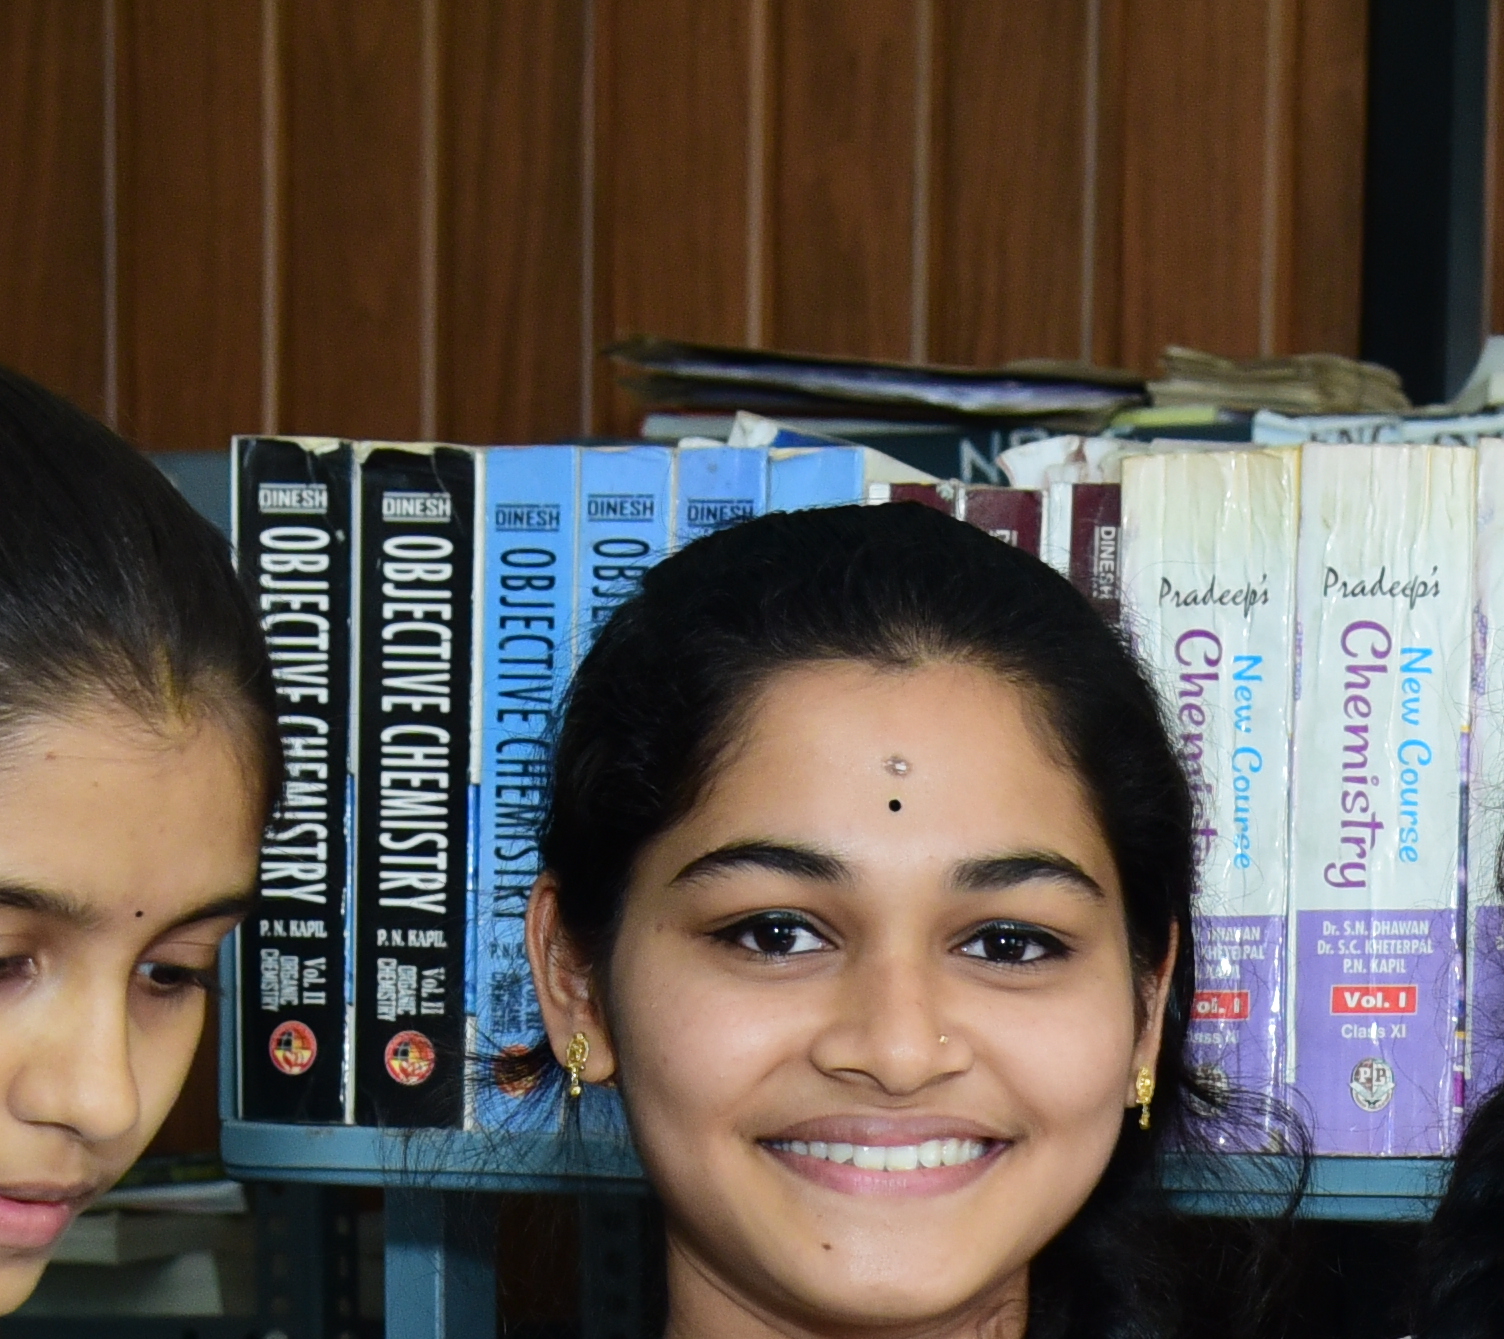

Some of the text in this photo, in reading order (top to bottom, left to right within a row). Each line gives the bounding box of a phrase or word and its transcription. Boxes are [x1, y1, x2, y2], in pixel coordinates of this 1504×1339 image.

[383, 497, 451, 517] DINESH
[496, 508, 560, 528] DINESH
[1322, 566, 1441, 609] Pradeep's
[496, 548, 557, 723] OBJECTIVE
[378, 534, 453, 914] OBJECTIVE CHEMISTRY
[1324, 620, 1393, 889] Chemistry
[1397, 647, 1433, 863] New Course
[407, 930, 447, 948] KAPIL
[1343, 992, 1391, 1008] Vol.
[1341, 1023, 1407, 1039] Class XI
